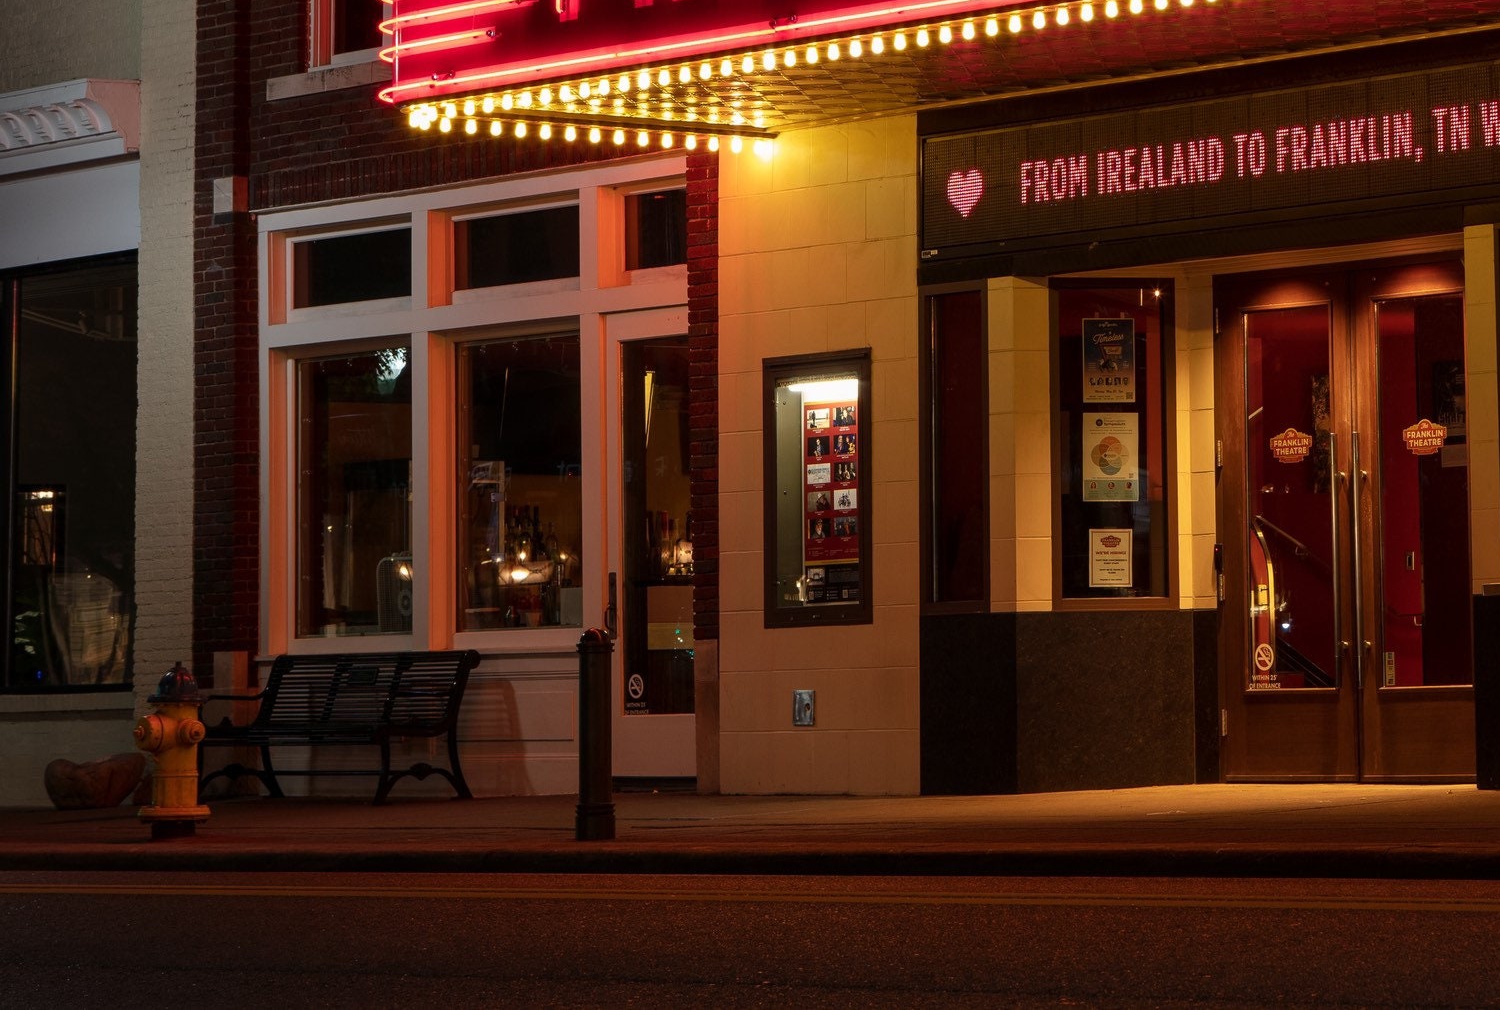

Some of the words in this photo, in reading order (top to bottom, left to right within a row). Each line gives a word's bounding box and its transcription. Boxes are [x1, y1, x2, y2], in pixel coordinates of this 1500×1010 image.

[1019, 154, 1088, 205] FROM
[1096, 136, 1225, 196] IREALAND
[1231, 131, 1267, 178] TO
[1275, 111, 1424, 174] FRANKLIN,
[1430, 104, 1471, 154] TN
[1406, 430, 1443, 439] FRANKLIN
[1273, 438, 1309, 447] FRANKLIN
[1408, 438, 1442, 447] THEATRE
[1275, 446, 1307, 455] THEATRE
